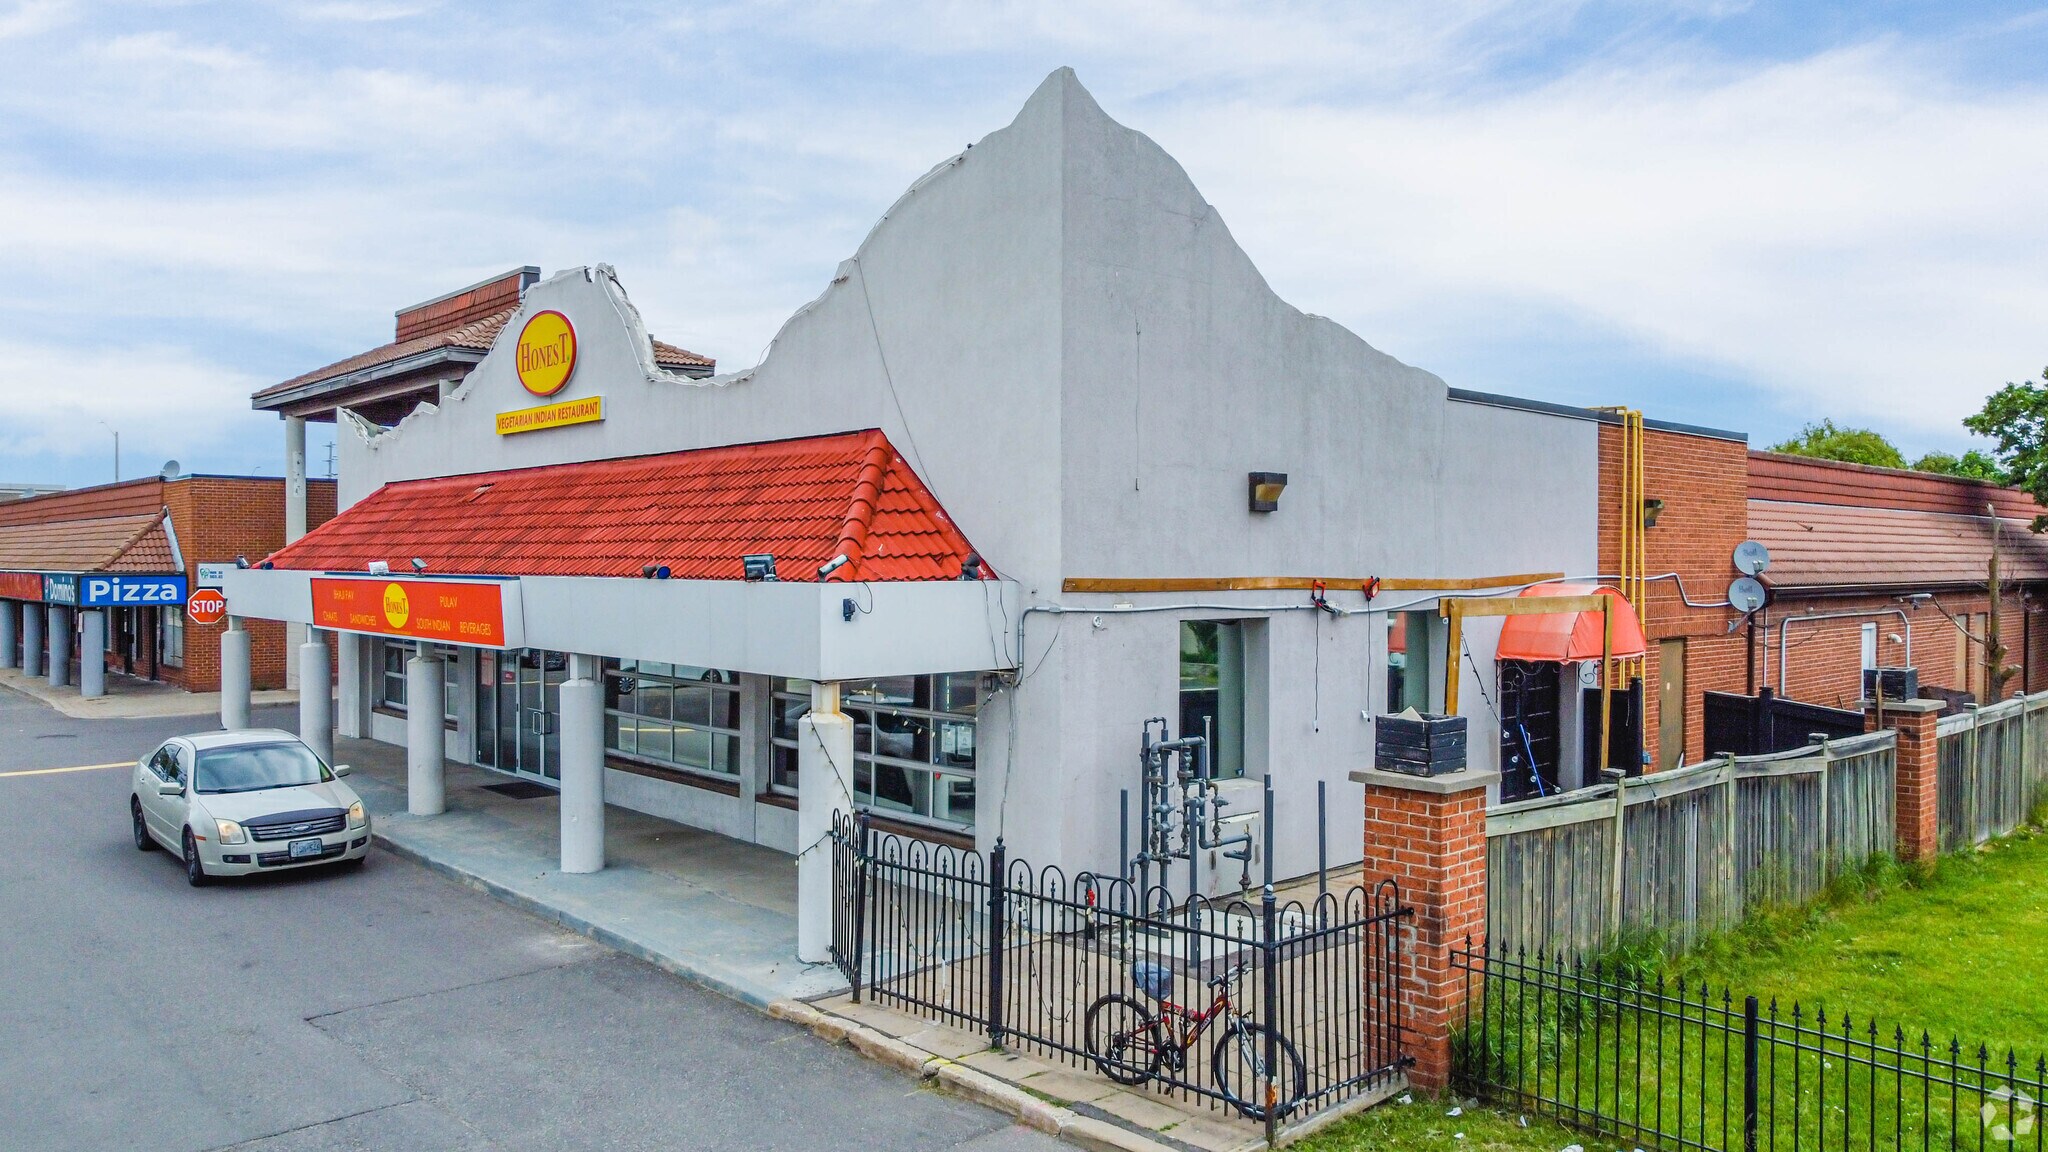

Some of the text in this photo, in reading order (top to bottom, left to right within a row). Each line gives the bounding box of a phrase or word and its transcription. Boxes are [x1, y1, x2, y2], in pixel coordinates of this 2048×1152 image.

[498, 401, 599, 430] VEGETARIAN INDIAN RESTAURANT
[50, 576, 75, 603] Domino's
[89, 577, 178, 602] Pizza
[191, 600, 224, 614] STOP
[350, 613, 377, 626] SANDWICHES
[416, 618, 451, 631] SOUTH INDIAN
[460, 621, 492, 636] BEVERAGES
